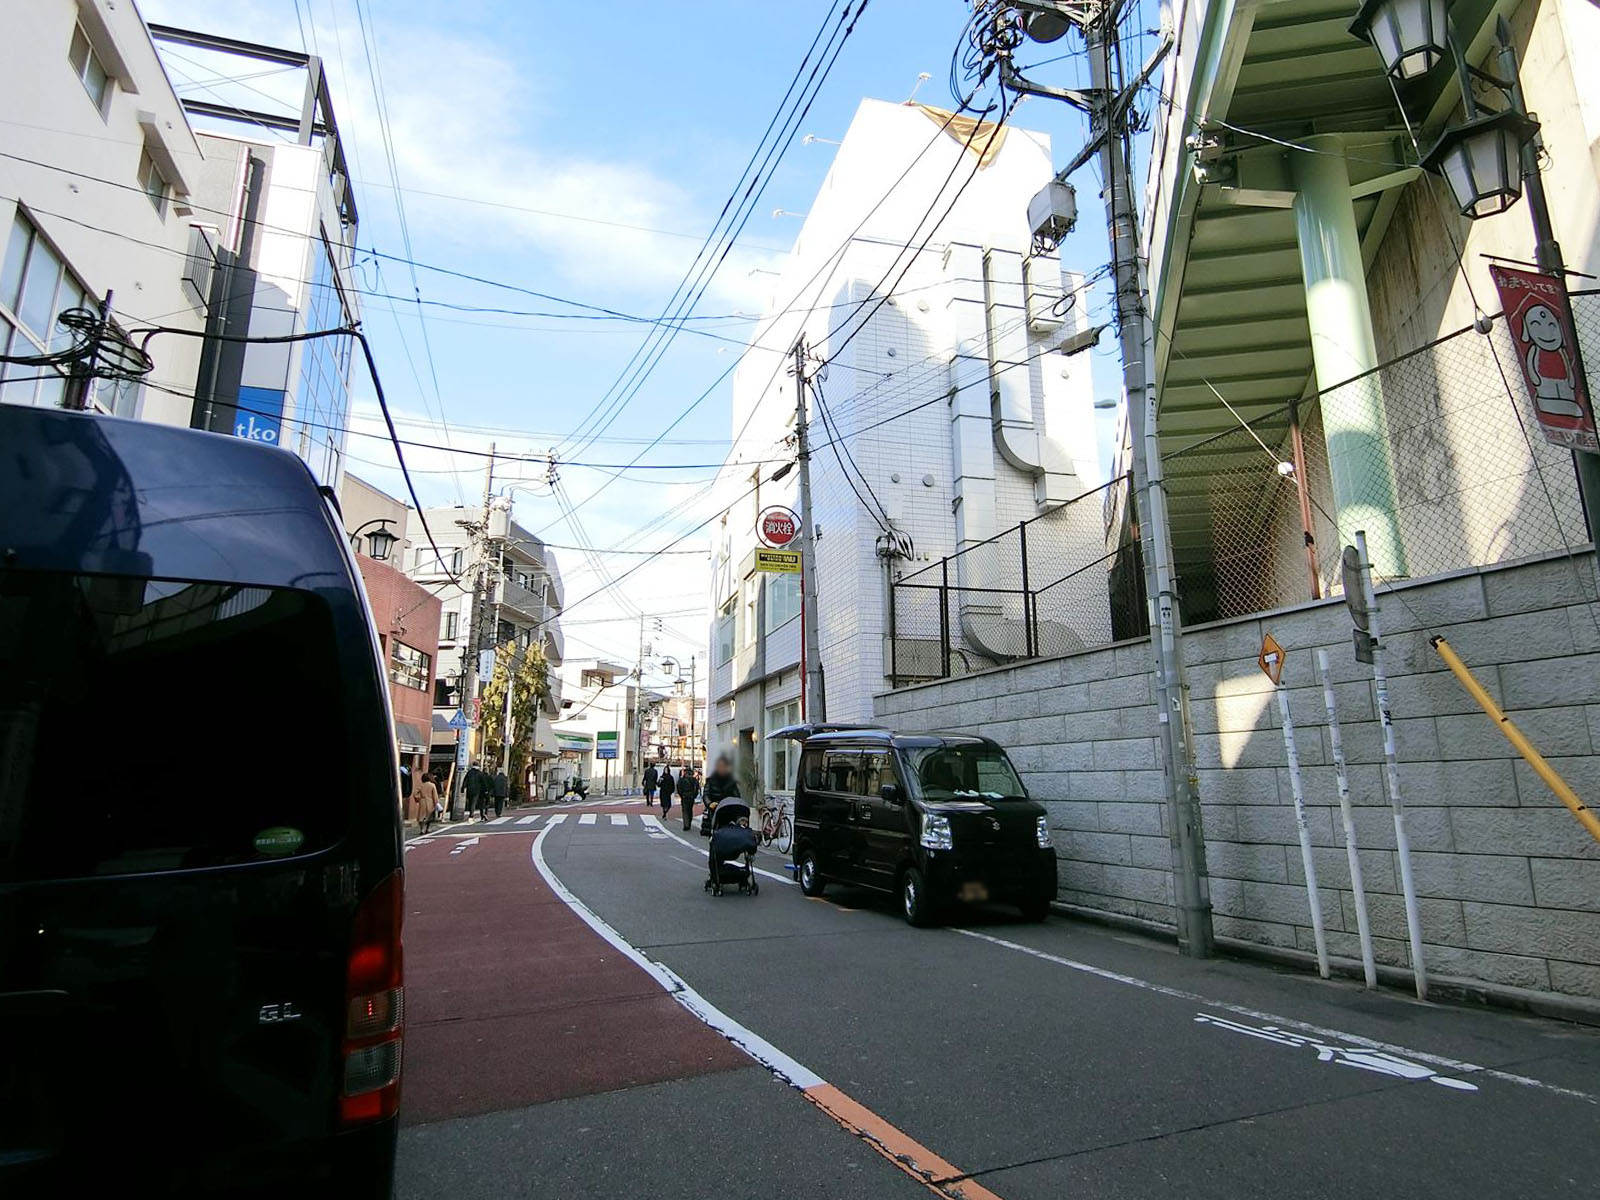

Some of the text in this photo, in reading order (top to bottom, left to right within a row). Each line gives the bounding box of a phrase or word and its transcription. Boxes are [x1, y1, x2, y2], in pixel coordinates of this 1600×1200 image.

[236, 416, 276, 442] tko
[766, 521, 792, 534] 消火栓
[259, 1002, 302, 1021] GL
